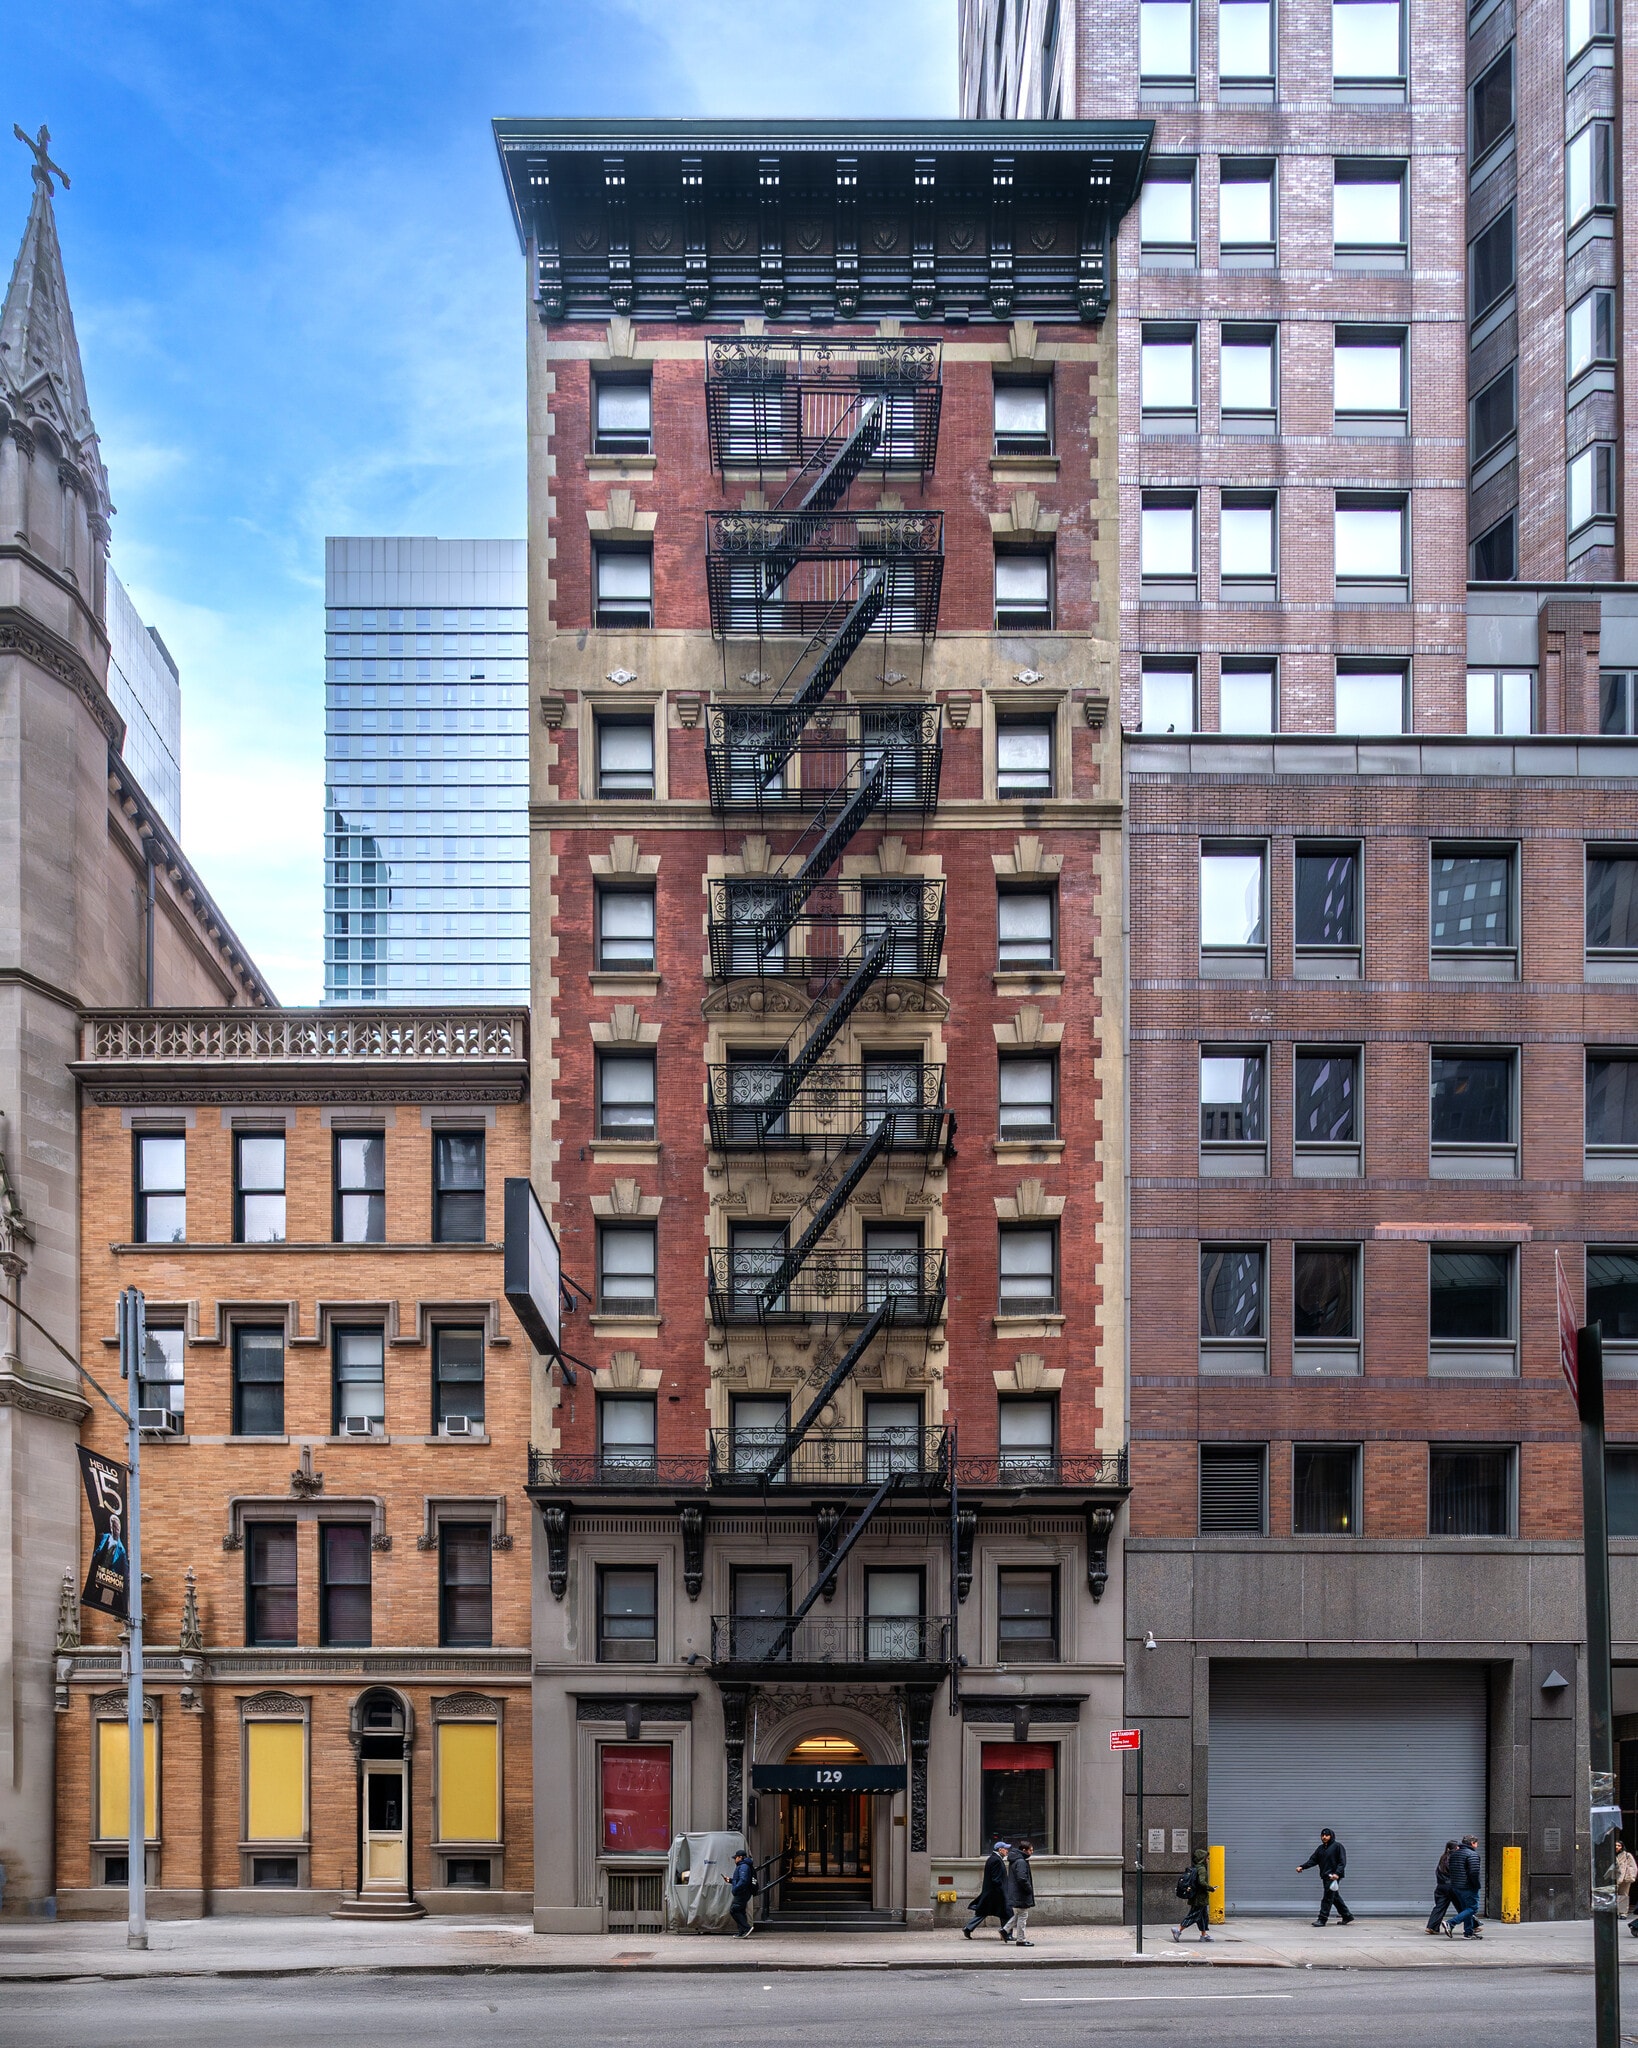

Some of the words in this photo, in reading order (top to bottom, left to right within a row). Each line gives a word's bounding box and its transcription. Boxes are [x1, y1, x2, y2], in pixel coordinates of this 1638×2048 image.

[89, 1458, 118, 1477] HELLO
[89, 1467, 123, 1515] 15
[95, 1570, 124, 1588] MORMON
[816, 1770, 843, 1783] 129
